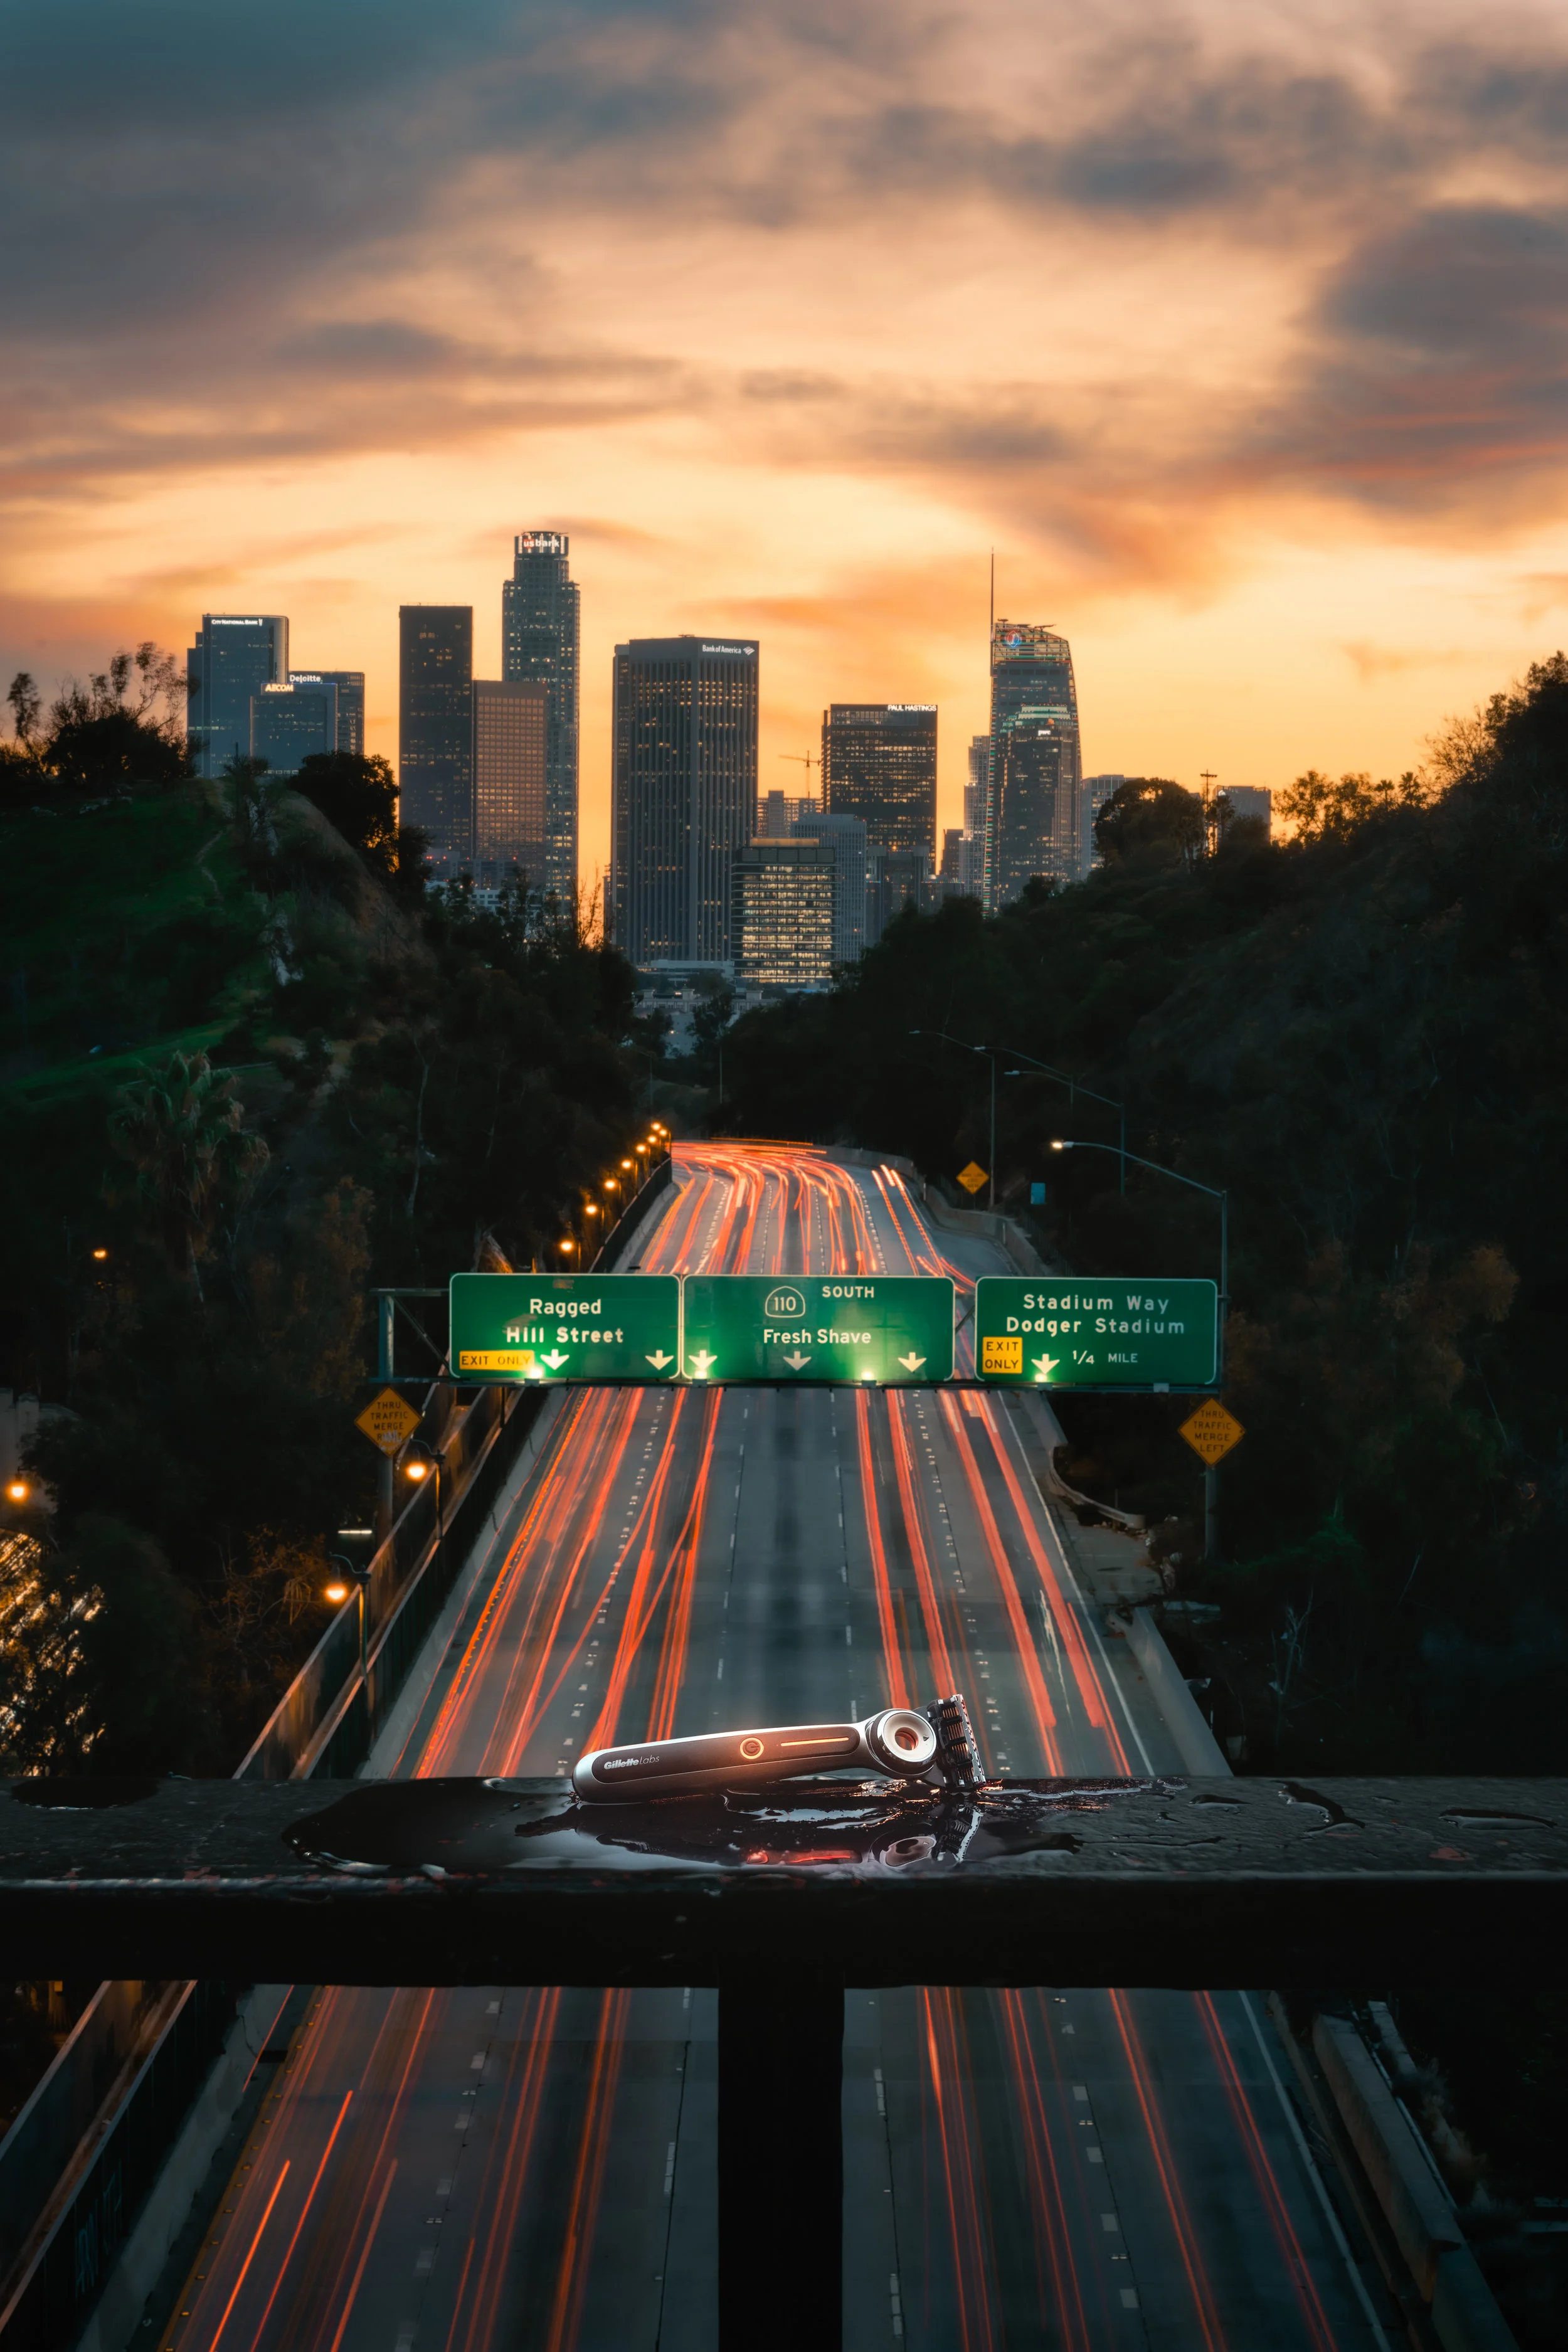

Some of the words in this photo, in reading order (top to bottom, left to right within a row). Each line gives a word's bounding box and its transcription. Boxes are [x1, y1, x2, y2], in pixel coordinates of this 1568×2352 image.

[702, 644, 715, 652] Bank
[721, 645, 741, 654] America
[265, 684, 294, 692] AECOM
[822, 1286, 874, 1298] SOUTH
[530, 1298, 601, 1318] Ragged
[774, 1296, 796, 1311] 110
[1023, 1294, 1113, 1310] Stadium
[1127, 1296, 1169, 1314] Way
[1007, 1317, 1081, 1337] Dodger
[1094, 1318, 1184, 1333] Stadium
[506, 1327, 544, 1343] Hill
[556, 1327, 623, 1343] Street
[763, 1328, 812, 1343] Fresh
[817, 1328, 871, 1343] Shave
[985, 1341, 1019, 1351] EXIT
[461, 1355, 489, 1365] EXIT
[497, 1355, 531, 1365] ONLY
[1108, 1353, 1138, 1363] MILE
[985, 1359, 1019, 1369] ONLY
[377, 1401, 401, 1409] THRU
[371, 1411, 408, 1420] TRAFFIC
[1201, 1410, 1224, 1418] THRU
[374, 1422, 404, 1431] MERGE
[1194, 1421, 1232, 1430] TRAFFIC
[1195, 1433, 1230, 1441] MERGE
[1200, 1444, 1224, 1453] LEFT
